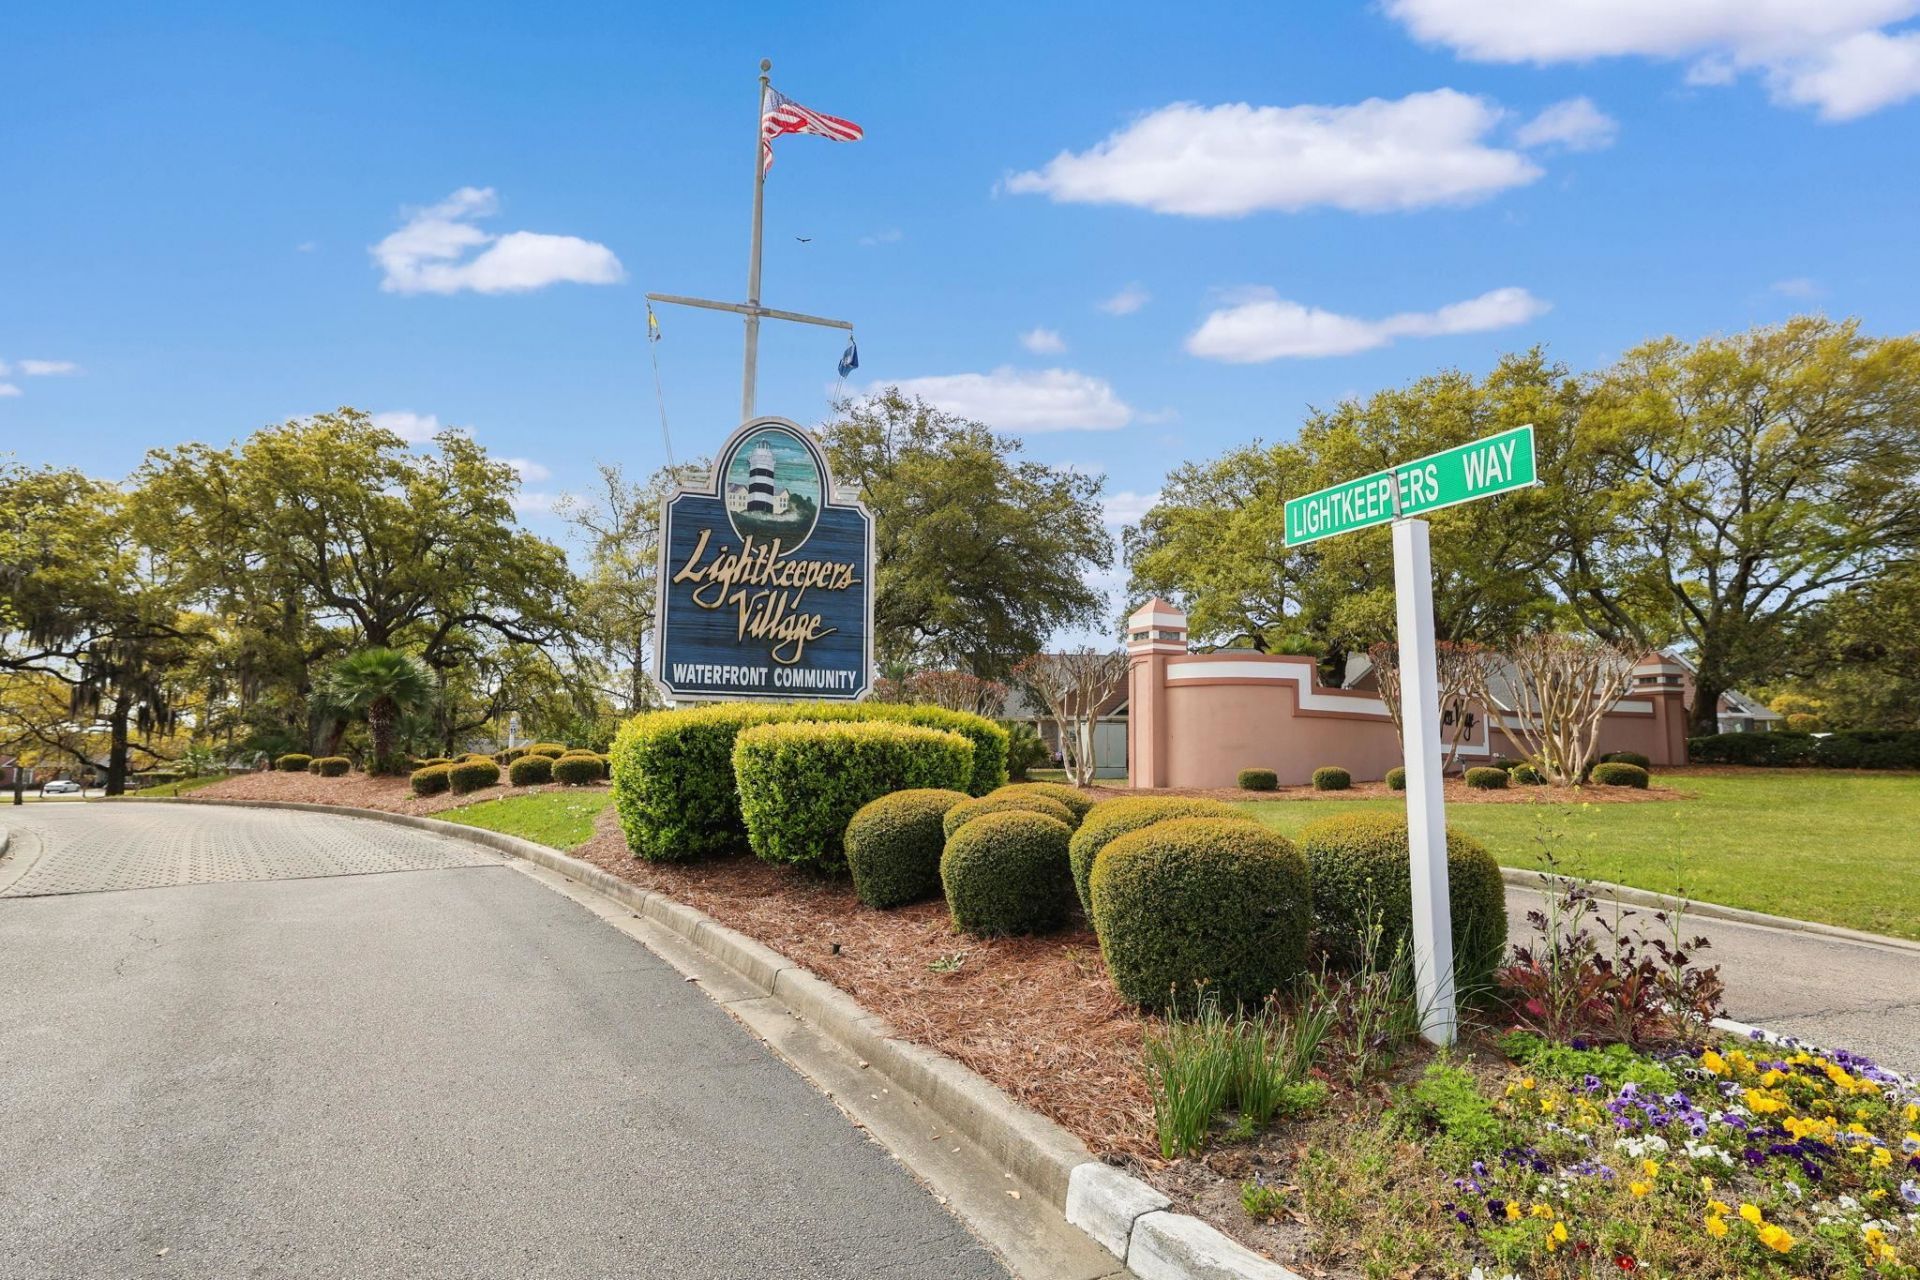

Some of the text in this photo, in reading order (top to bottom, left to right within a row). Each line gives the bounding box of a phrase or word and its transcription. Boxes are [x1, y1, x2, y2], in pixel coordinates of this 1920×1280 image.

[1293, 439, 1516, 538] LIGHTKEEPERS WAY
[673, 529, 861, 609] Lightkeepers
[729, 588, 838, 664] Village
[673, 663, 856, 689] WATERFRONT COMMUNITY
